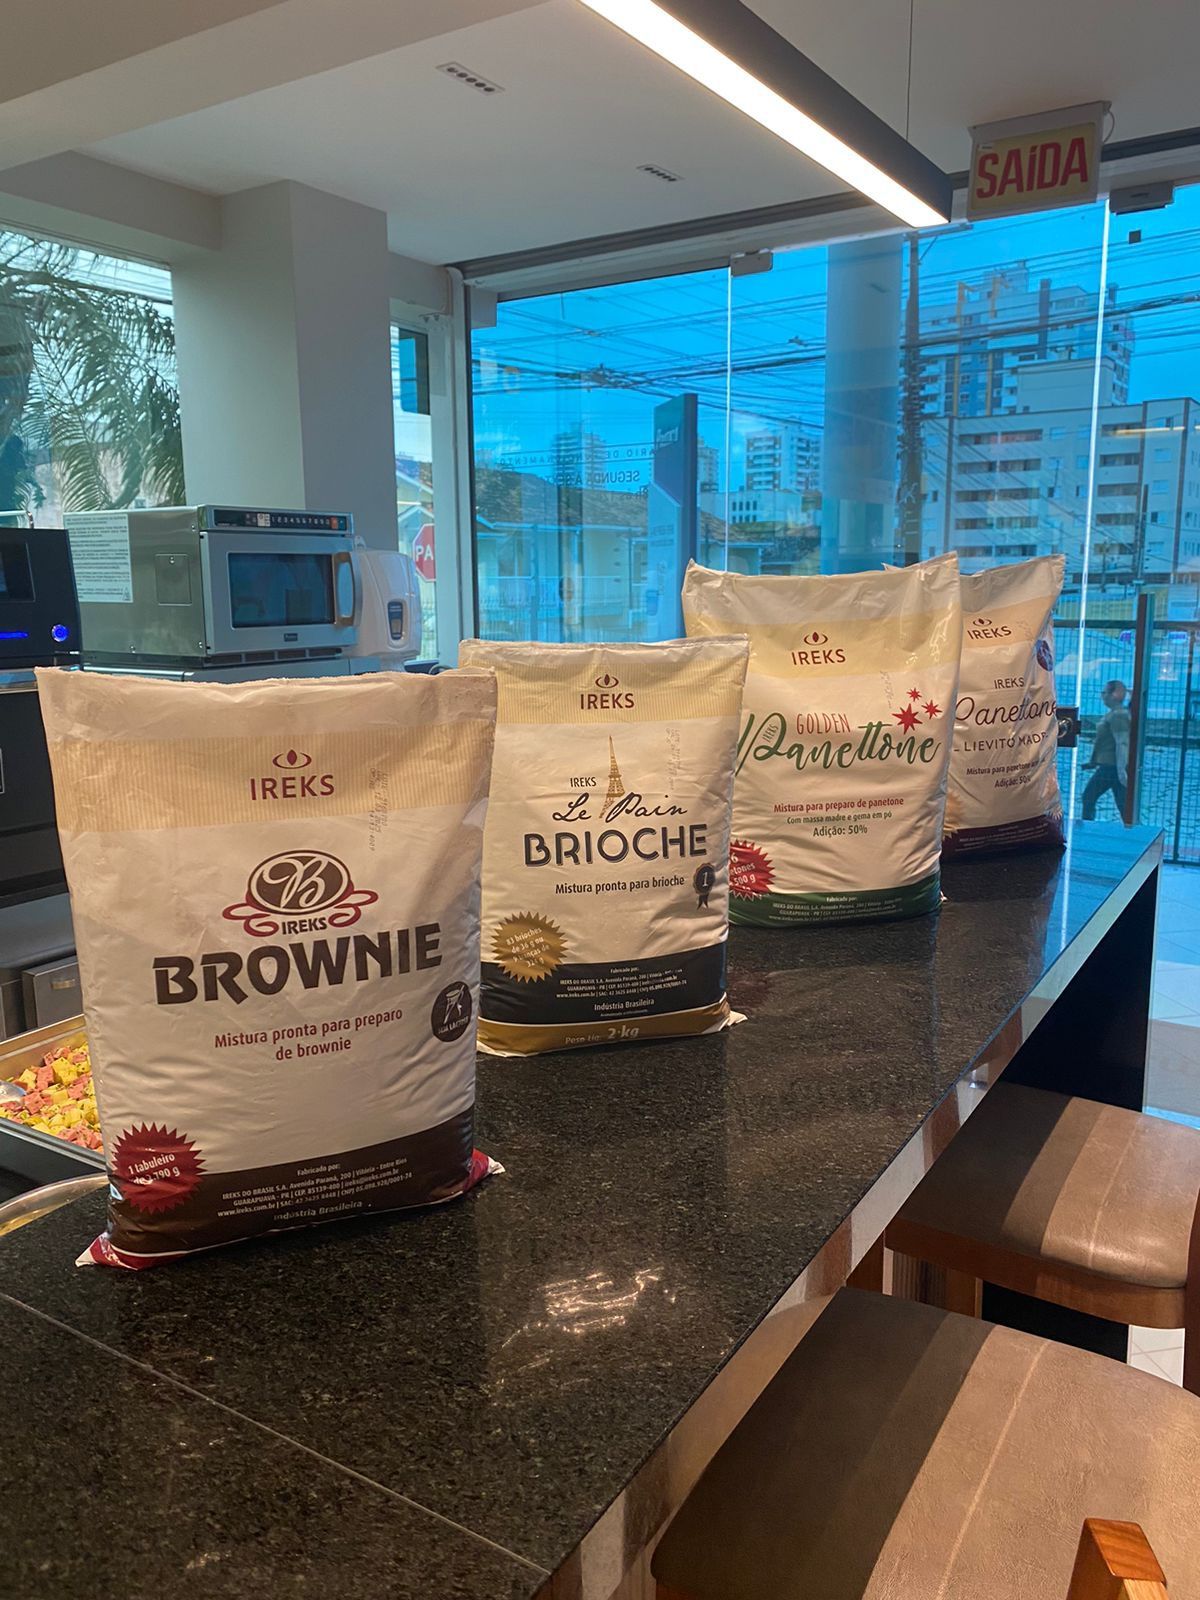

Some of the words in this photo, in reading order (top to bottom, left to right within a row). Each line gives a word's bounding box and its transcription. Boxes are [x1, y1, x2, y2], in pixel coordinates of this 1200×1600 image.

[976, 137, 1088, 198] SAÍDA
[415, 544, 434, 562] PA
[967, 626, 1012, 640] IREKS
[792, 648, 846, 666] IREKS
[994, 677, 1025, 689] IREKS
[580, 692, 635, 710] IREKS
[796, 712, 852, 735] GOLDEN
[761, 723, 779, 744] IREKS
[735, 712, 942, 777] Panettone
[964, 738, 1016, 751] LIEVITO
[966, 767, 991, 776] Mistura
[992, 766, 1006, 775] para
[250, 774, 335, 801] IREKS
[570, 776, 597, 788] IREKS
[994, 777, 1018, 788] Adição:
[552, 792, 592, 822] Le
[605, 791, 688, 823] Pain
[773, 803, 804, 813] Mistura
[805, 802, 824, 813] para
[825, 801, 855, 812] preparo
[856, 799, 867, 808] de
[868, 797, 905, 810] panetone
[787, 816, 801, 825] Com
[803, 815, 824, 824] massa
[825, 813, 847, 823] madre
[853, 813, 871, 823] gema
[872, 812, 883, 820] em
[883, 810, 892, 820] pó
[813, 825, 846, 837] Adição:
[847, 823, 868, 835] 50%
[524, 823, 708, 867] BRIOCHE
[555, 883, 593, 895] Mistura
[595, 881, 627, 895] pronta
[629, 879, 650, 892] para
[652, 875, 685, 888] brioche
[749, 873, 756, 884] g
[282, 917, 328, 935] IREKS
[514, 927, 543, 943] brioches
[511, 946, 520, 954] de
[535, 936, 544, 944] ou
[152, 922, 443, 1005] BROWNIE
[594, 1002, 624, 1011] Indústria
[625, 998, 655, 1009] Brasileira
[214, 1030, 269, 1049] Mistura
[272, 1024, 318, 1045] pronta
[321, 1018, 352, 1038] para
[354, 1008, 404, 1032] preparo
[275, 1046, 293, 1062] de
[296, 1038, 352, 1059] brownie
[128, 1165, 134, 1175] 1
[134, 1154, 176, 1174] tabuleiro
[172, 1166, 181, 1177] g
[297, 1165, 328, 1177] Fabricado
[327, 1163, 341, 1172] por:
[222, 1191, 241, 1200] IREKS
[242, 1189, 252, 1197] DO
[252, 1186, 275, 1195] BRASIL
[275, 1184, 288, 1192] S.A.
[289, 1179, 315, 1189] Avenida
[233, 1194, 276, 1206] GUARAPUAVA
[318, 1200, 363, 1215] Brasileira
[217, 1203, 276, 1217] www.ireks.com.br
